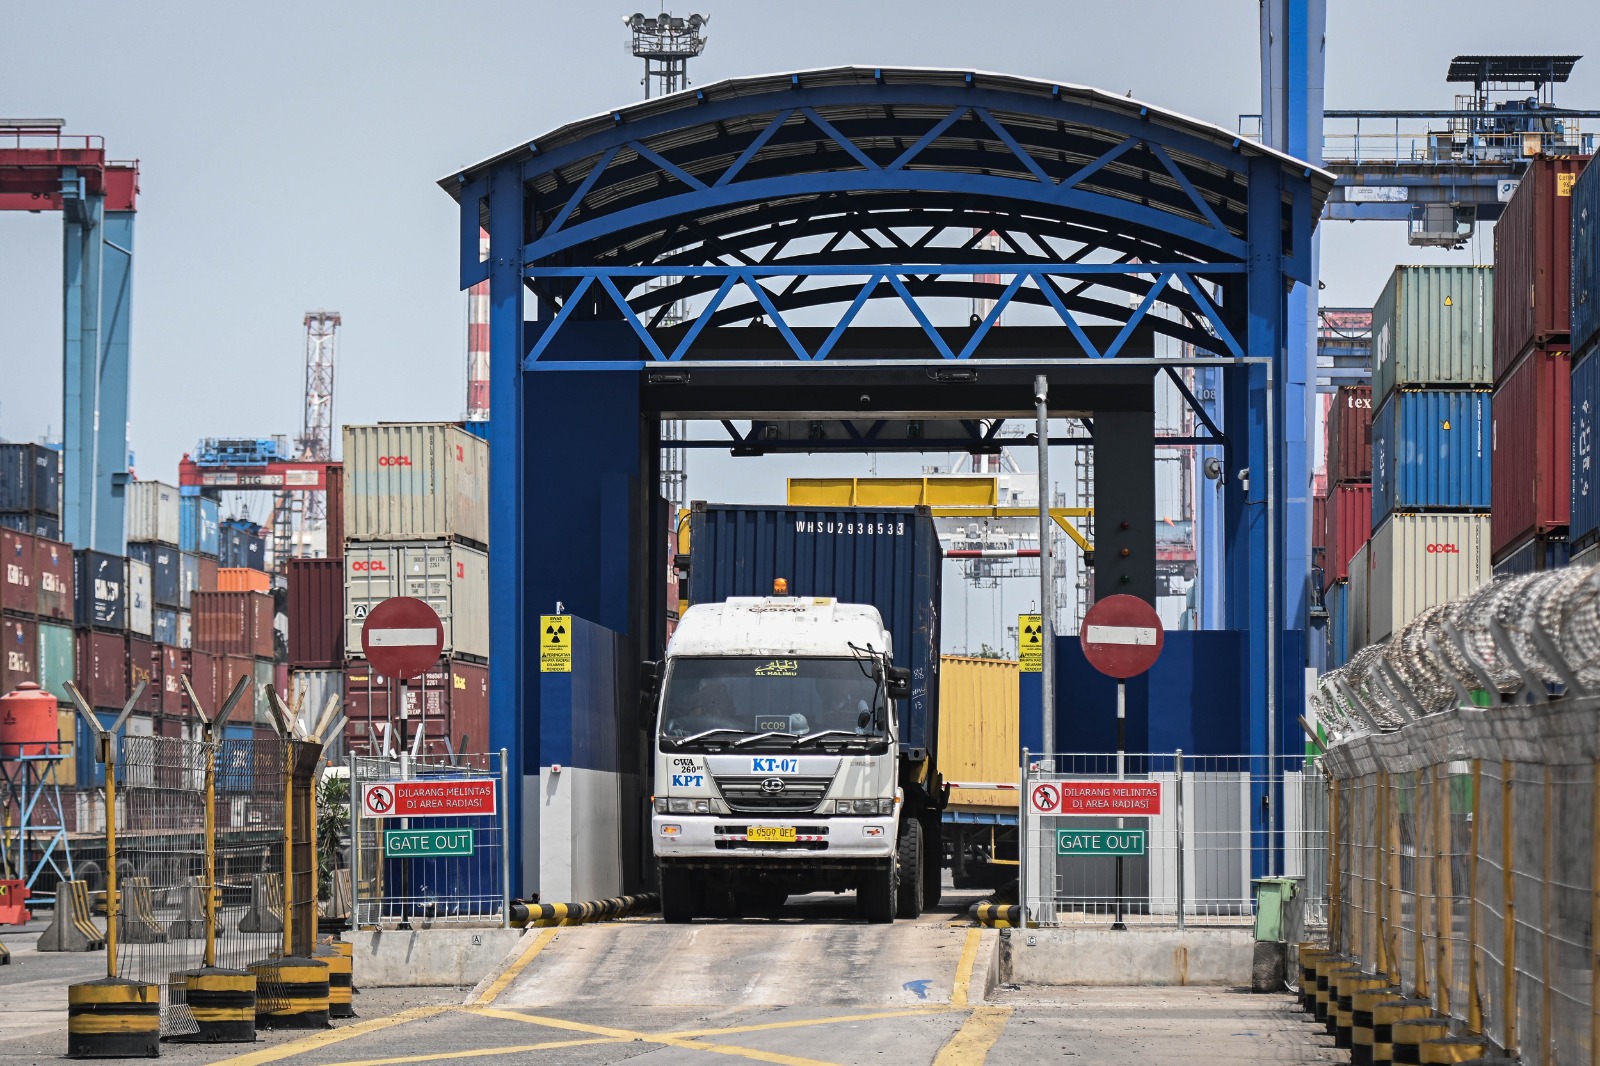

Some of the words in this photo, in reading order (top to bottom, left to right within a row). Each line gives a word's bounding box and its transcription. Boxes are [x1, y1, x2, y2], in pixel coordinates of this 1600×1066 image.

[1348, 396, 1372, 408] tex
[379, 456, 412, 466] OOCL
[1426, 544, 1459, 554] OOCL
[352, 561, 386, 572] OOCL
[761, 722, 785, 730] CC09
[752, 758, 797, 772] KT-07
[672, 775, 703, 786] KPT
[398, 789, 443, 798] DILARANG
[446, 787, 491, 796] MELINTAS
[1064, 788, 1110, 797] DILARANG
[1113, 788, 1158, 796] MELINTAS
[406, 800, 417, 808] DI
[420, 800, 443, 808] AREA
[446, 798, 482, 807] RADIASI
[1072, 800, 1083, 808] DI
[1086, 800, 1110, 808] AREA
[1112, 799, 1149, 808] RADIASI
[390, 836, 430, 851] GATE
[435, 835, 468, 849] OUT
[1061, 836, 1100, 849] GATE
[1106, 836, 1140, 849] OUT
